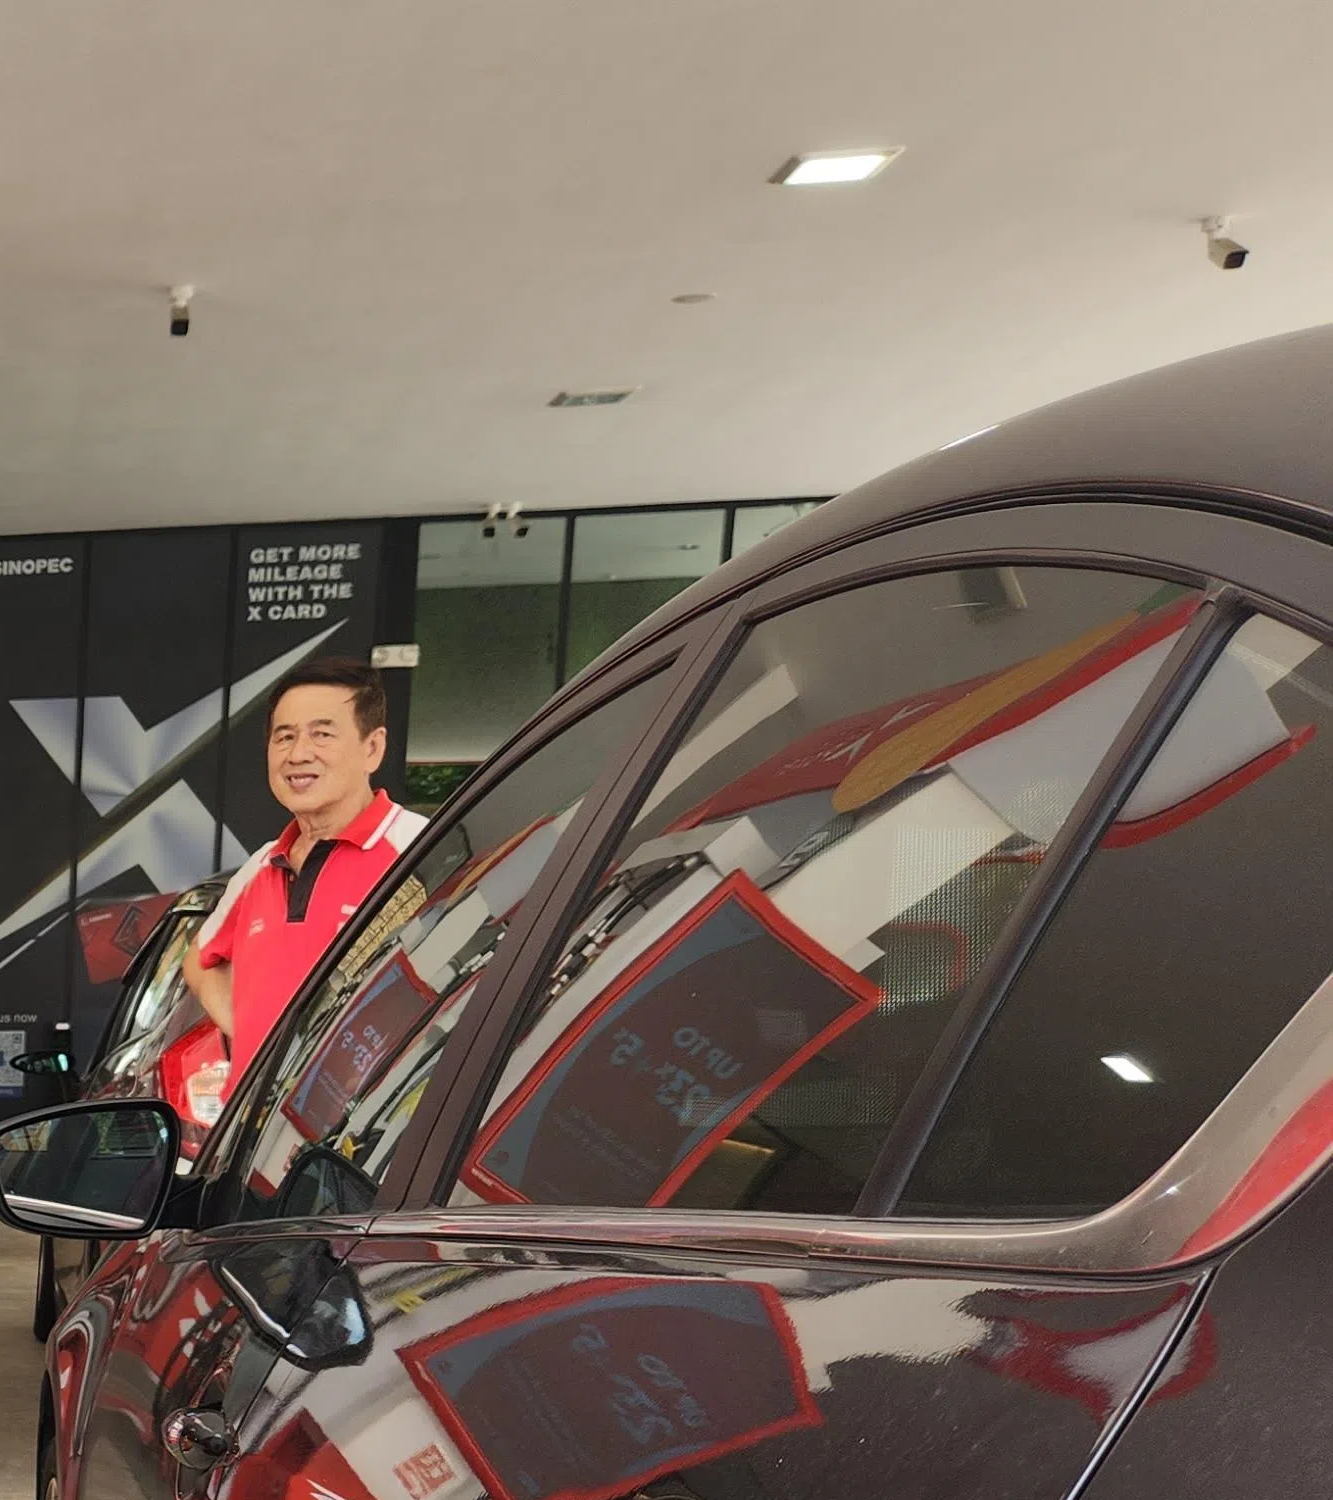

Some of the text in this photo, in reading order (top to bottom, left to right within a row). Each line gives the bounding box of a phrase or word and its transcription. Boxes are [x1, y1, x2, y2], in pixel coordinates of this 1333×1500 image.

[250, 543, 361, 564] GET MORE
[247, 563, 343, 583] MILEAGE
[247, 581, 353, 603] WITH THE
[246, 603, 326, 622] X CARD
[14, 1012, 37, 1023] now
